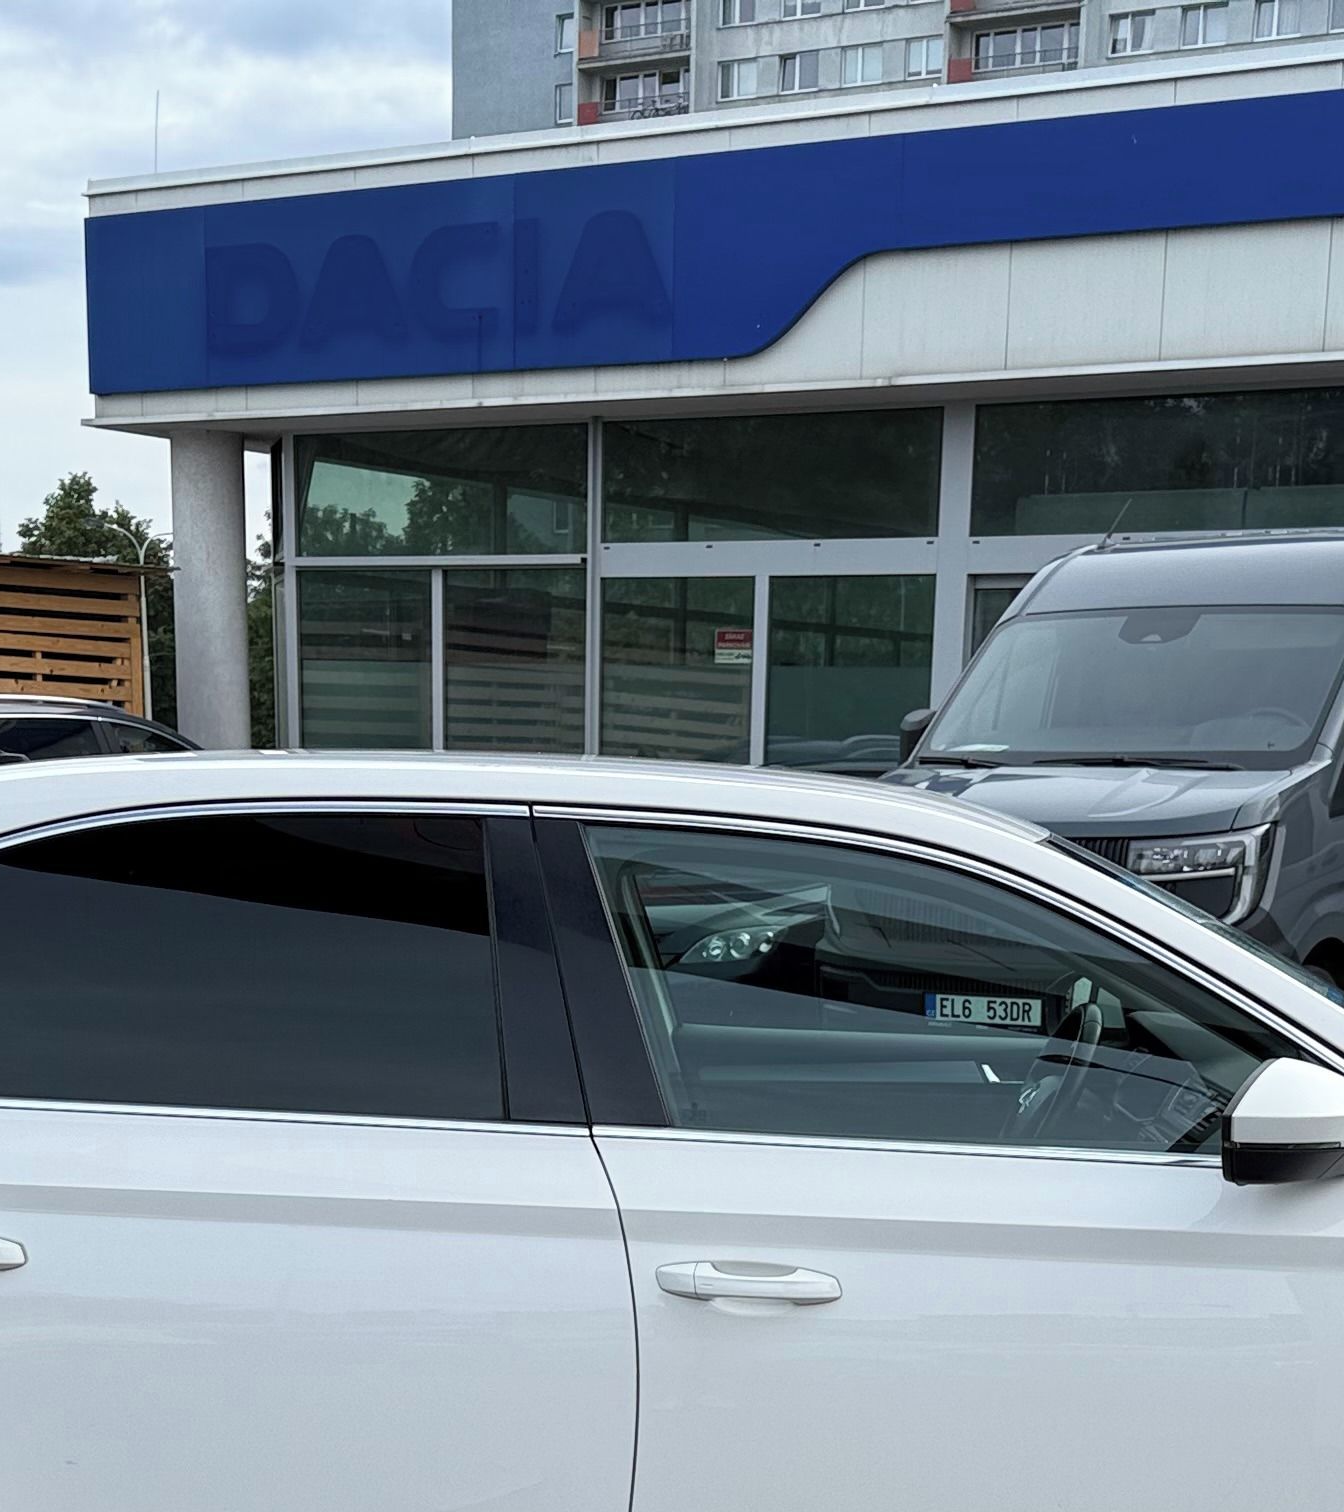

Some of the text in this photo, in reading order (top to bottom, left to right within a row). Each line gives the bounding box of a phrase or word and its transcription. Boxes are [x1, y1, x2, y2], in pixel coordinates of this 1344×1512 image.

[204, 208, 670, 355] DACIA
[939, 997, 972, 1019] EL6
[986, 999, 1032, 1023] 53DR
